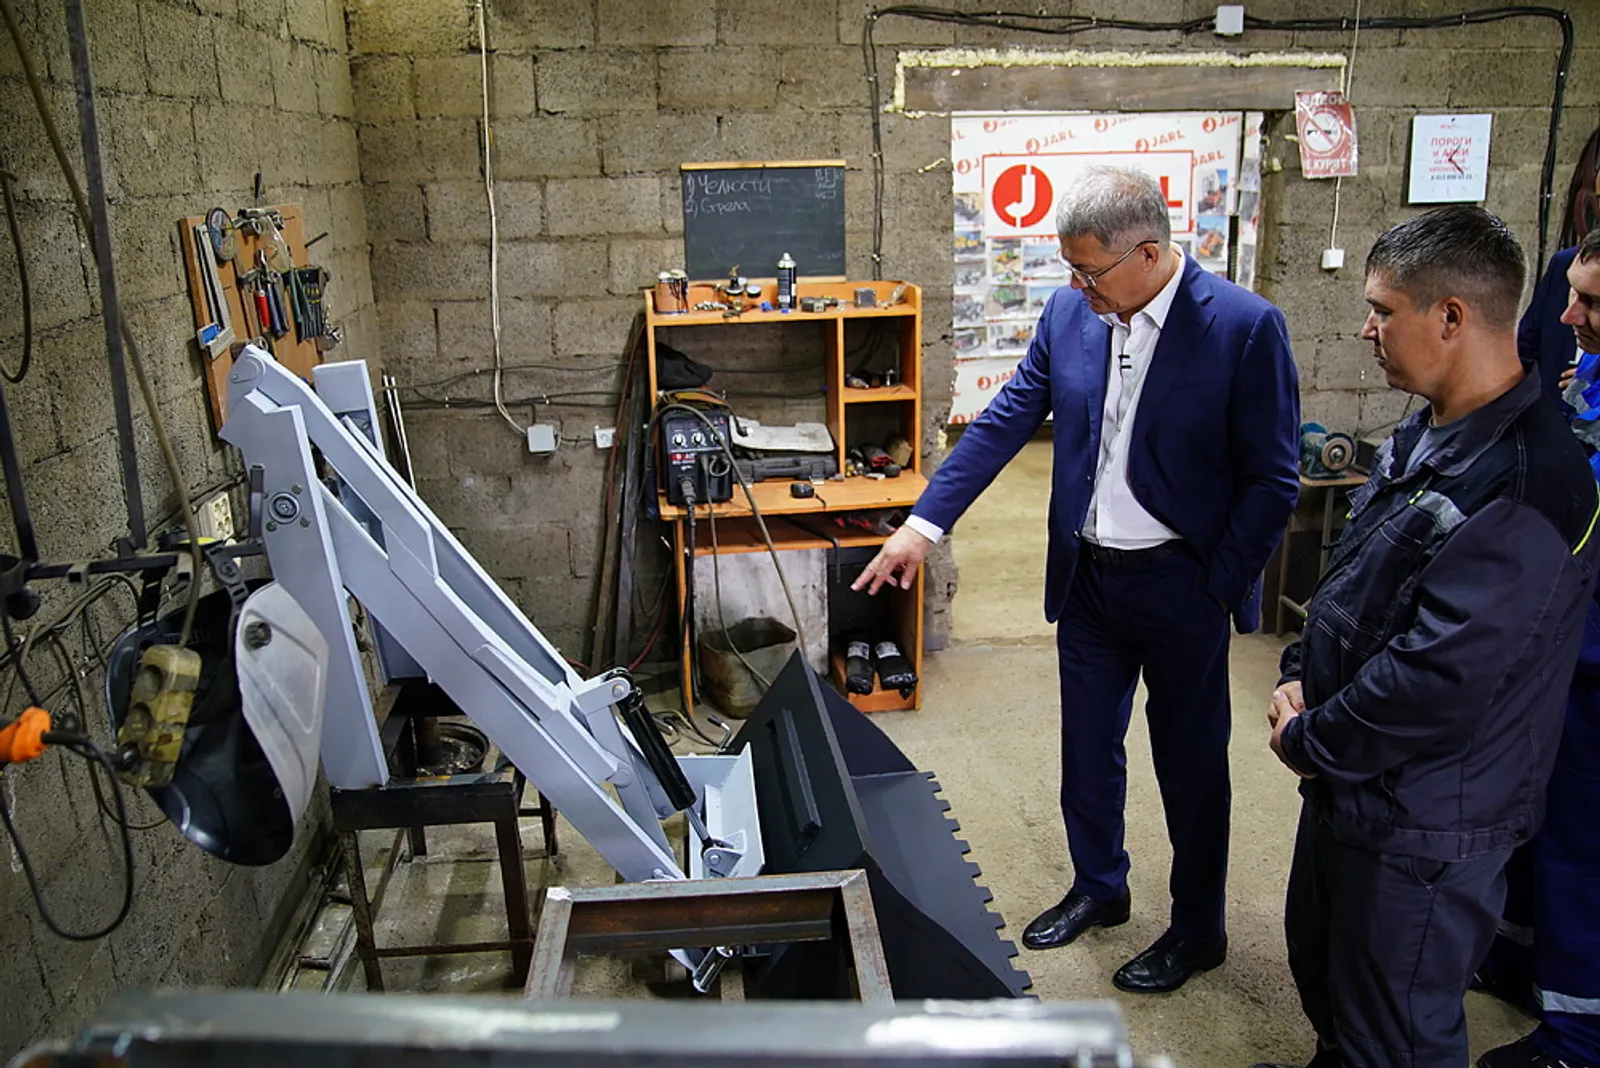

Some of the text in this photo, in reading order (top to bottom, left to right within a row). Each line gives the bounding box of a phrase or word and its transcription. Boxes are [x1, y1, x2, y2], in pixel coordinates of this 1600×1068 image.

[1043, 129, 1076, 147] JARL
[1152, 129, 1186, 147] JARL
[1431, 137, 1472, 147] ПОРОГИ
[995, 369, 1014, 384] JAR
